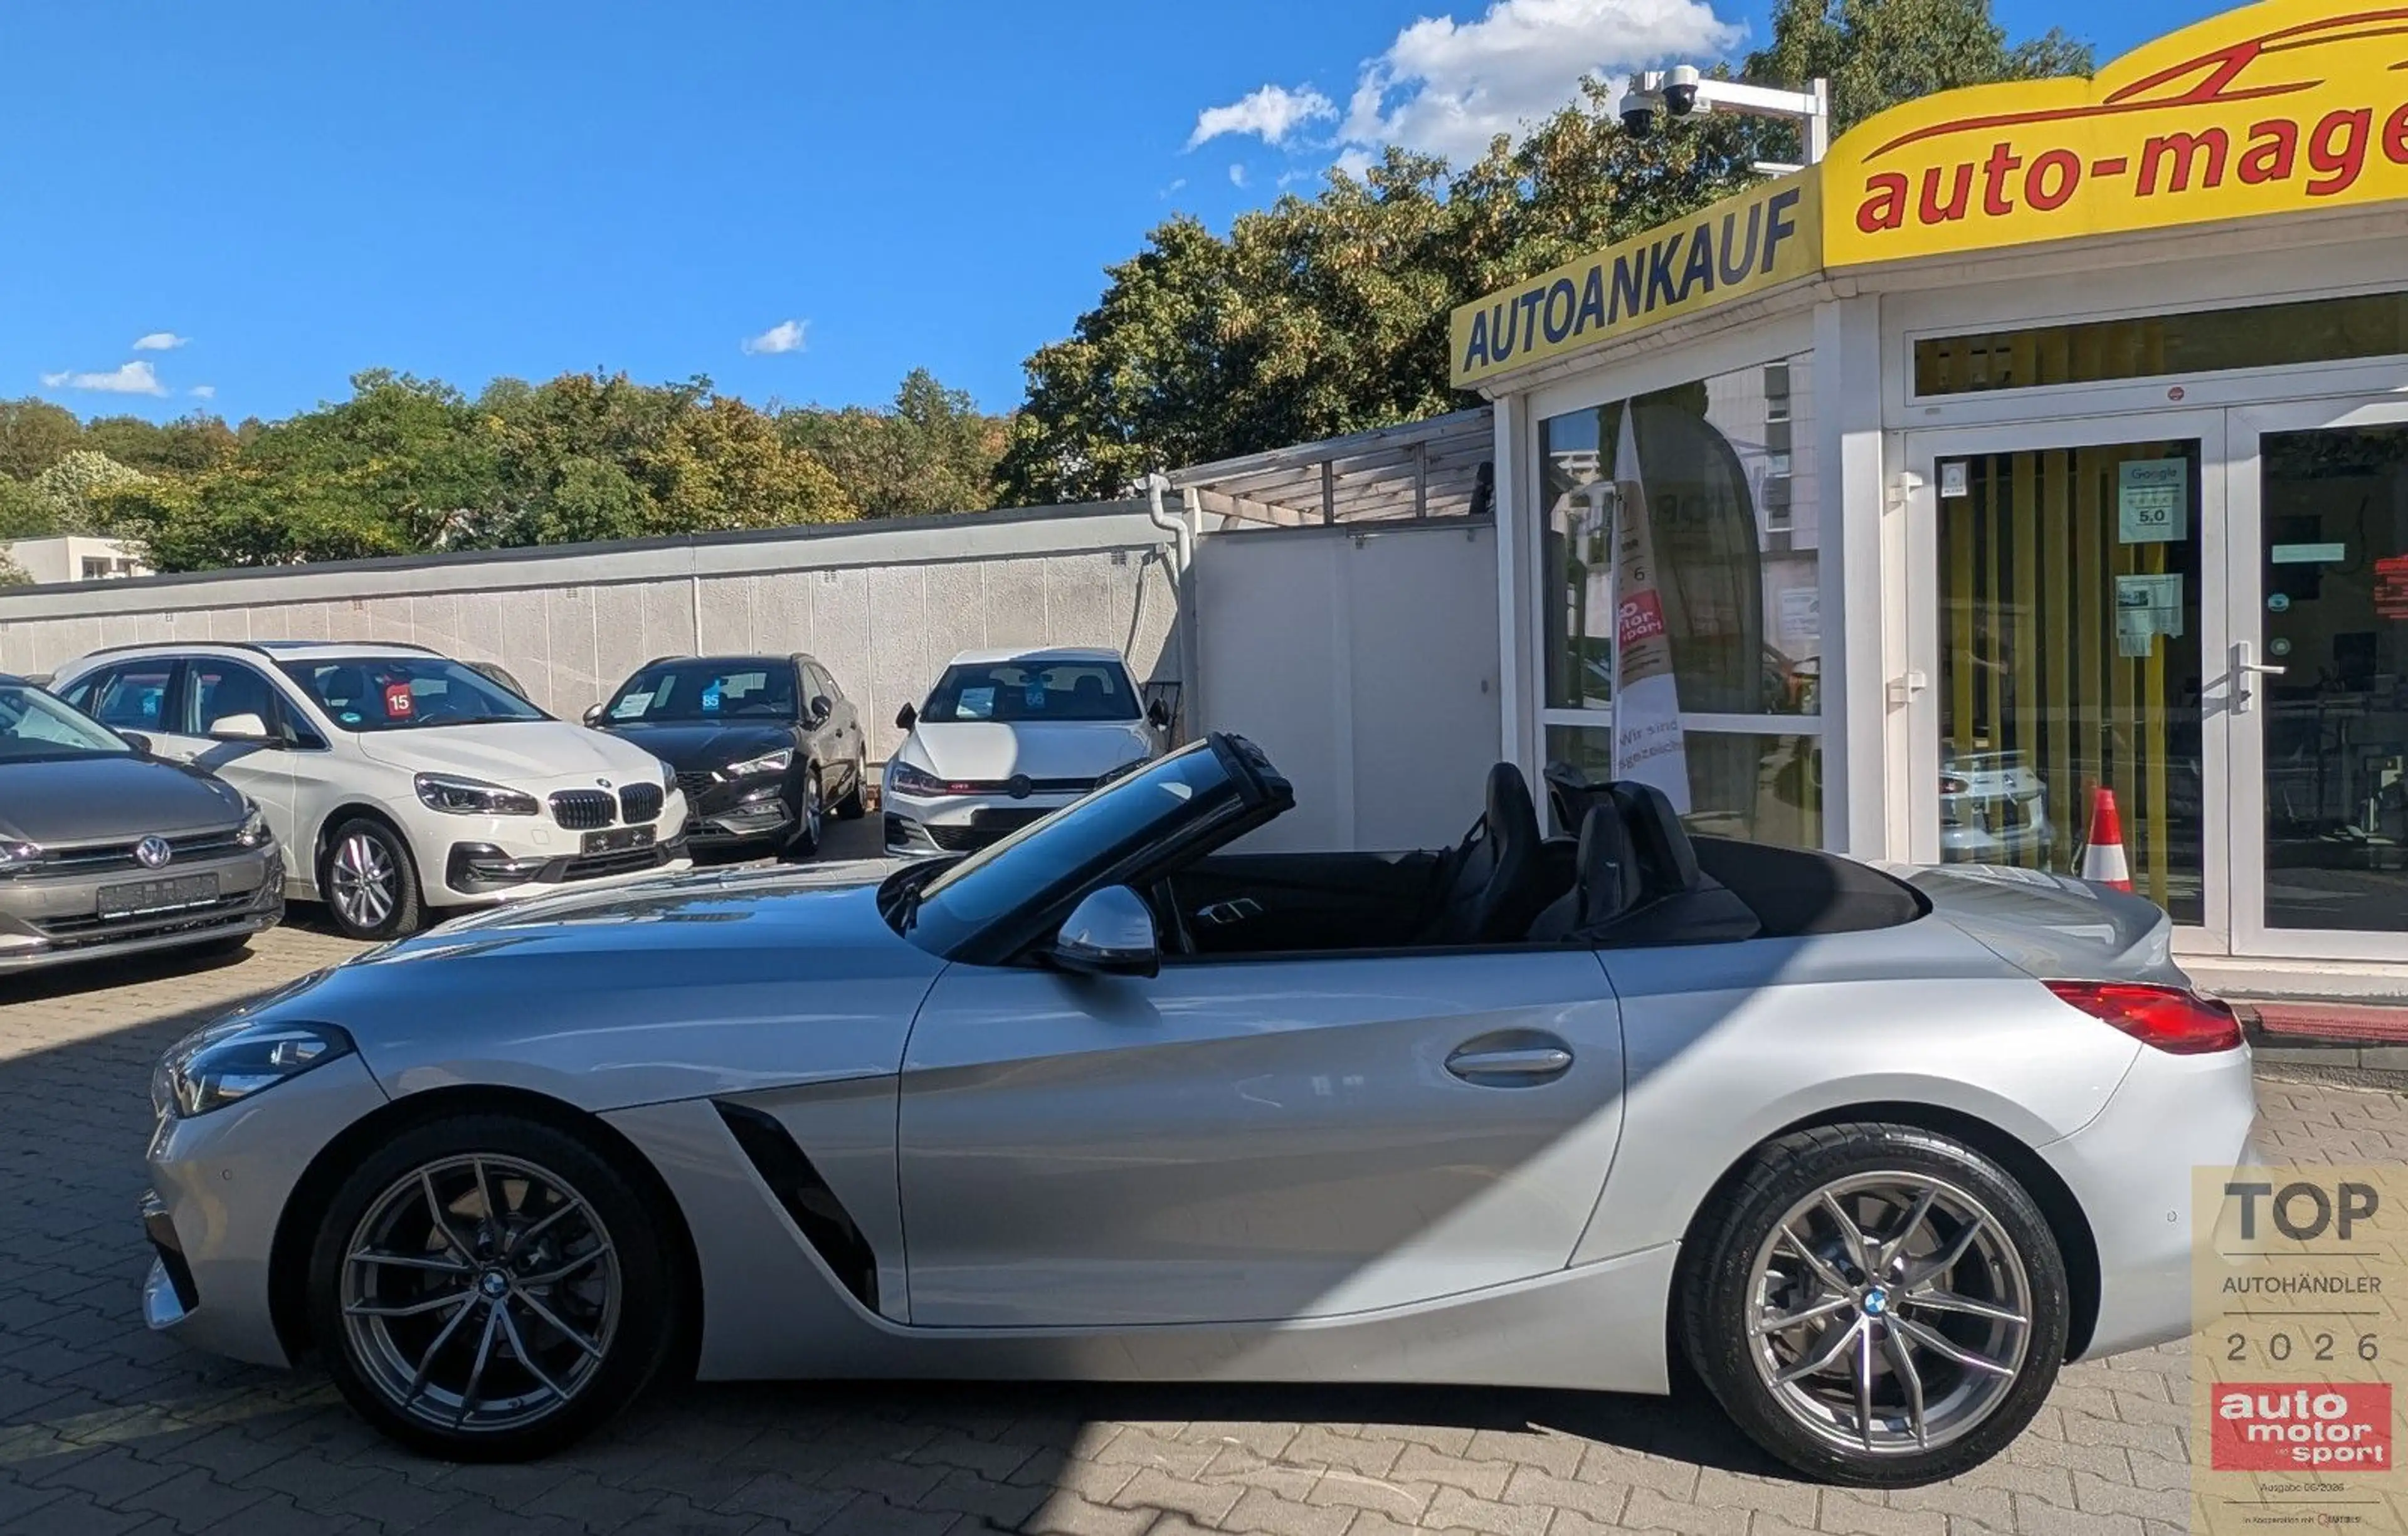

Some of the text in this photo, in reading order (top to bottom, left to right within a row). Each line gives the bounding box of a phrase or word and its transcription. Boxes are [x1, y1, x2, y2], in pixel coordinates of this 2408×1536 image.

[1462, 187, 1800, 373] AUTOANKAUF
[2139, 509, 2165, 522] 5.0
[389, 694, 409, 711] 15
[702, 695, 719, 707] 85
